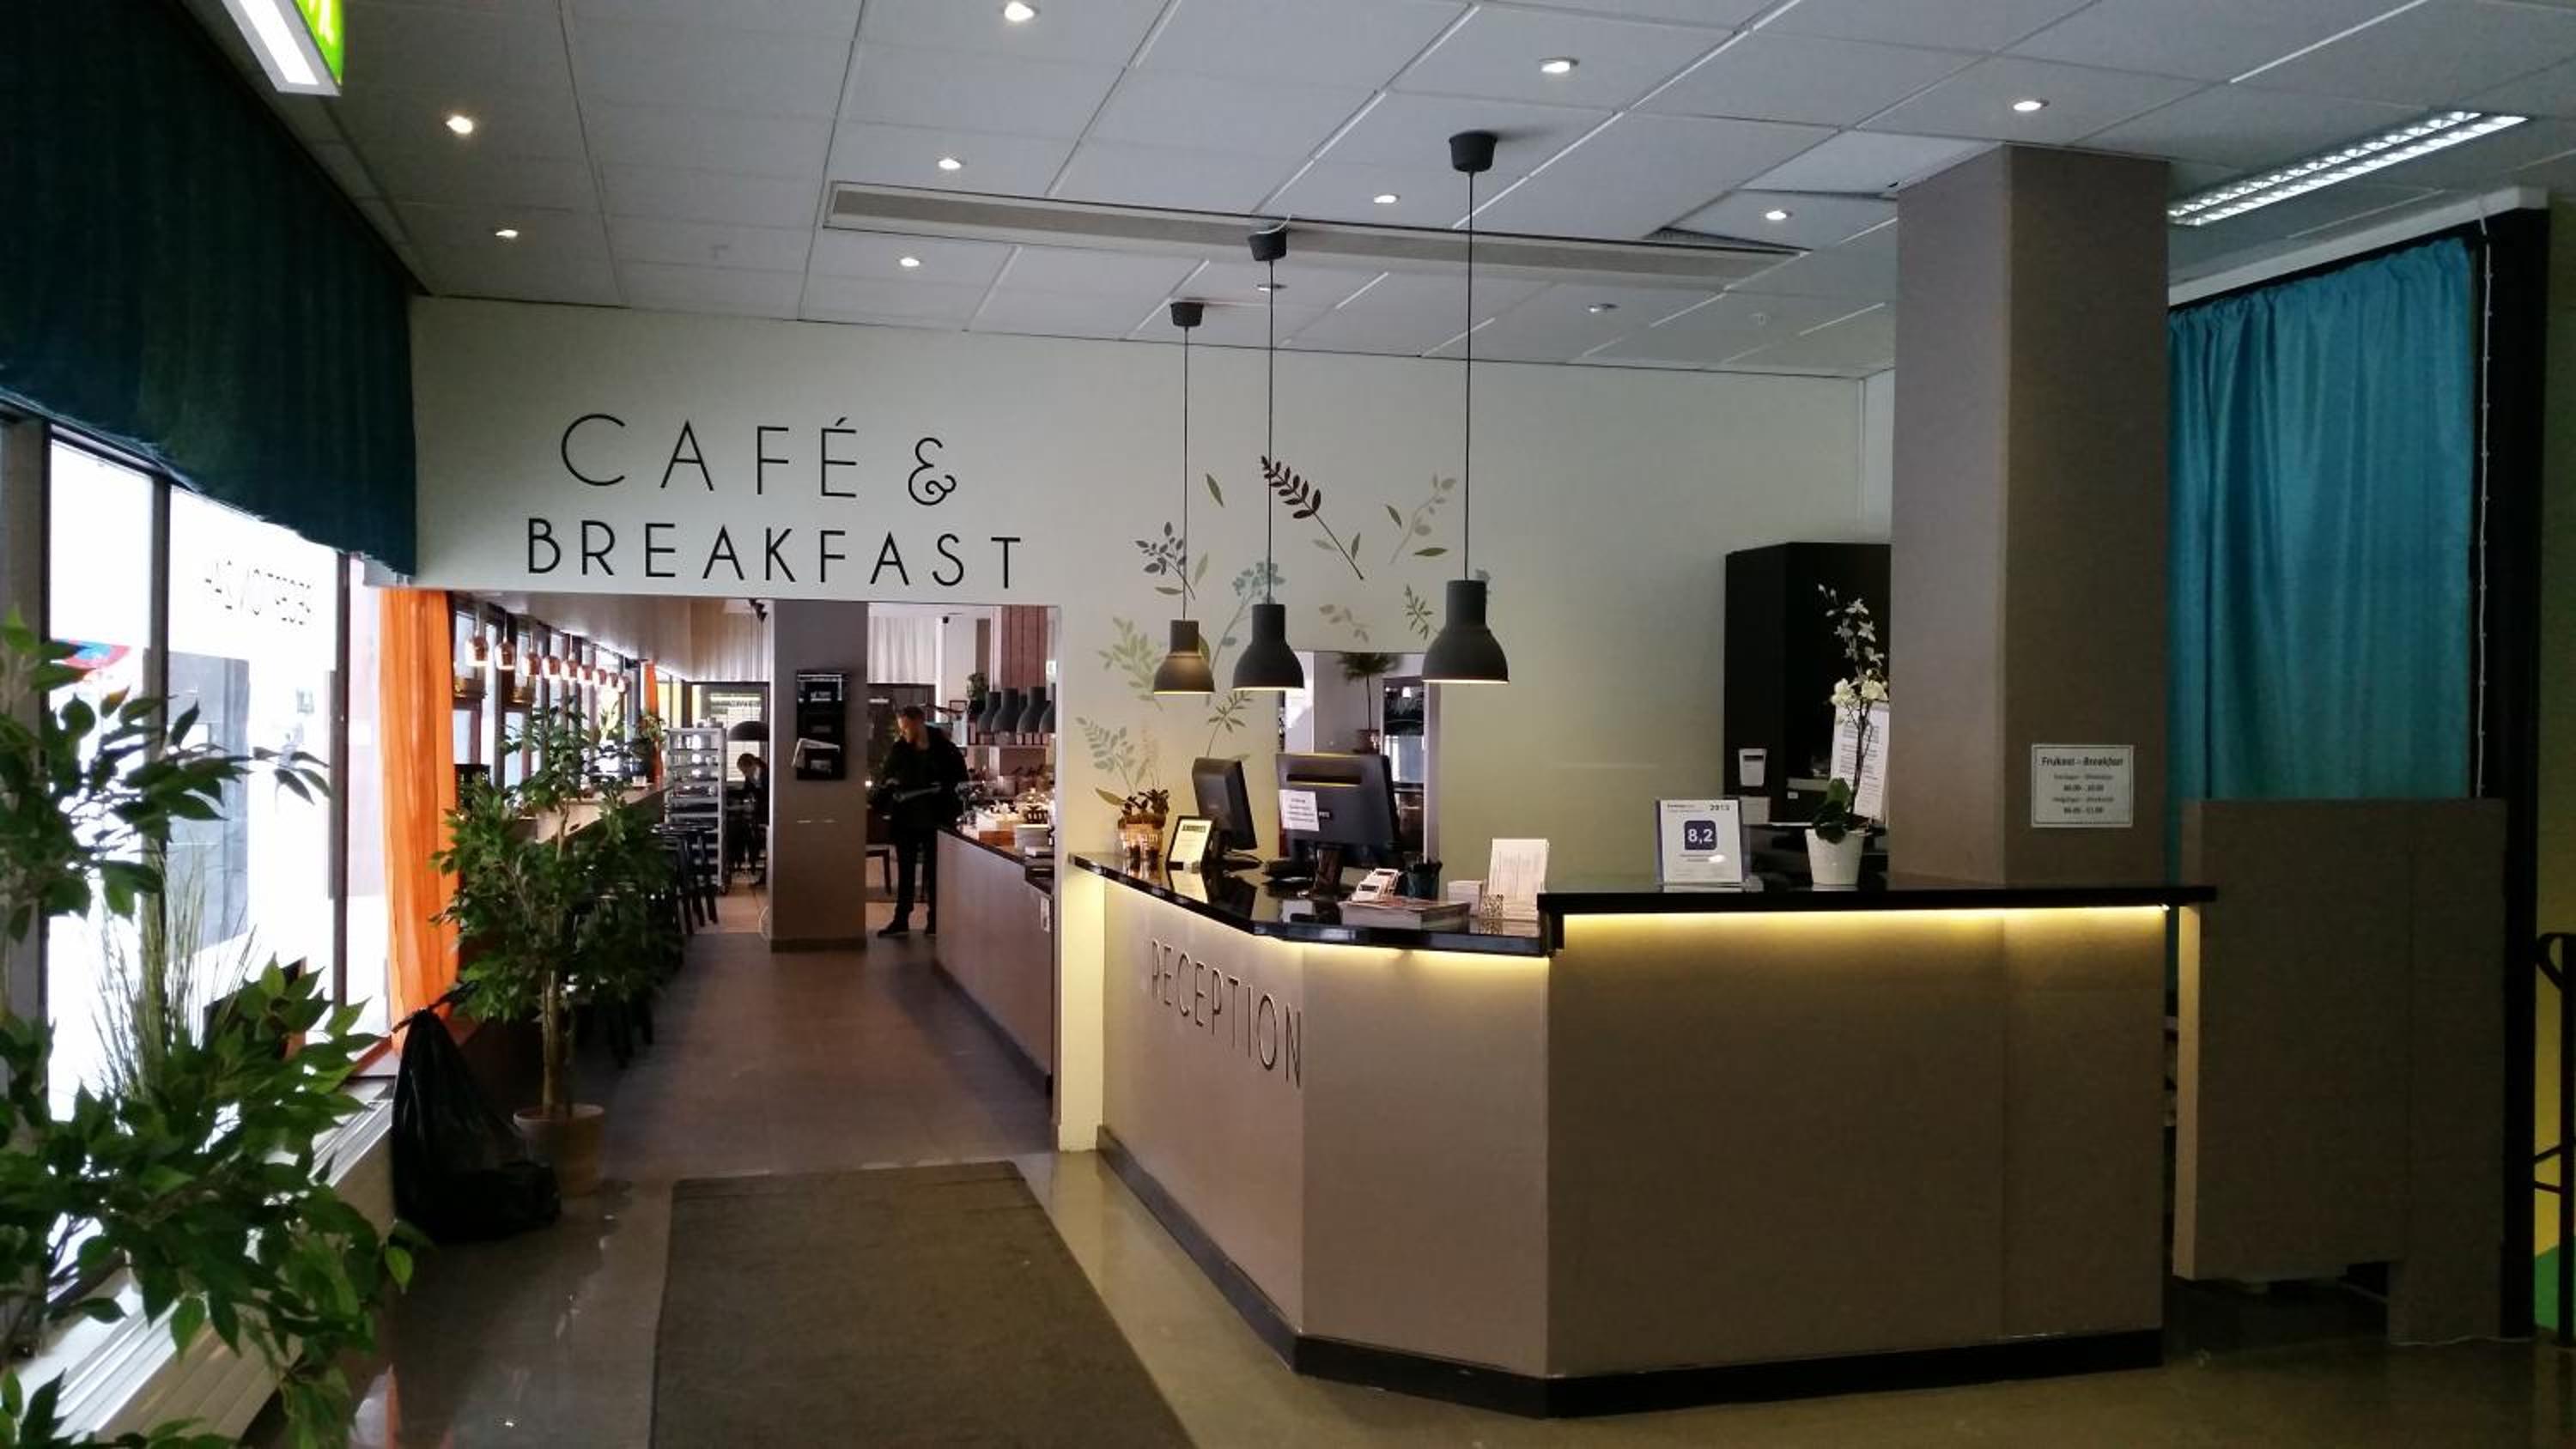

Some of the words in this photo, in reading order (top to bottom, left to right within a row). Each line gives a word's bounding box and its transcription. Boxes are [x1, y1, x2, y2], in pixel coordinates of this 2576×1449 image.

[562, 414, 857, 498] CAFÉ
[908, 437, 957, 506] &
[528, 518, 1021, 589] BREAKFAST
[1687, 828, 1713, 844] 8,2
[1151, 939, 1302, 1089] RECEPTION
